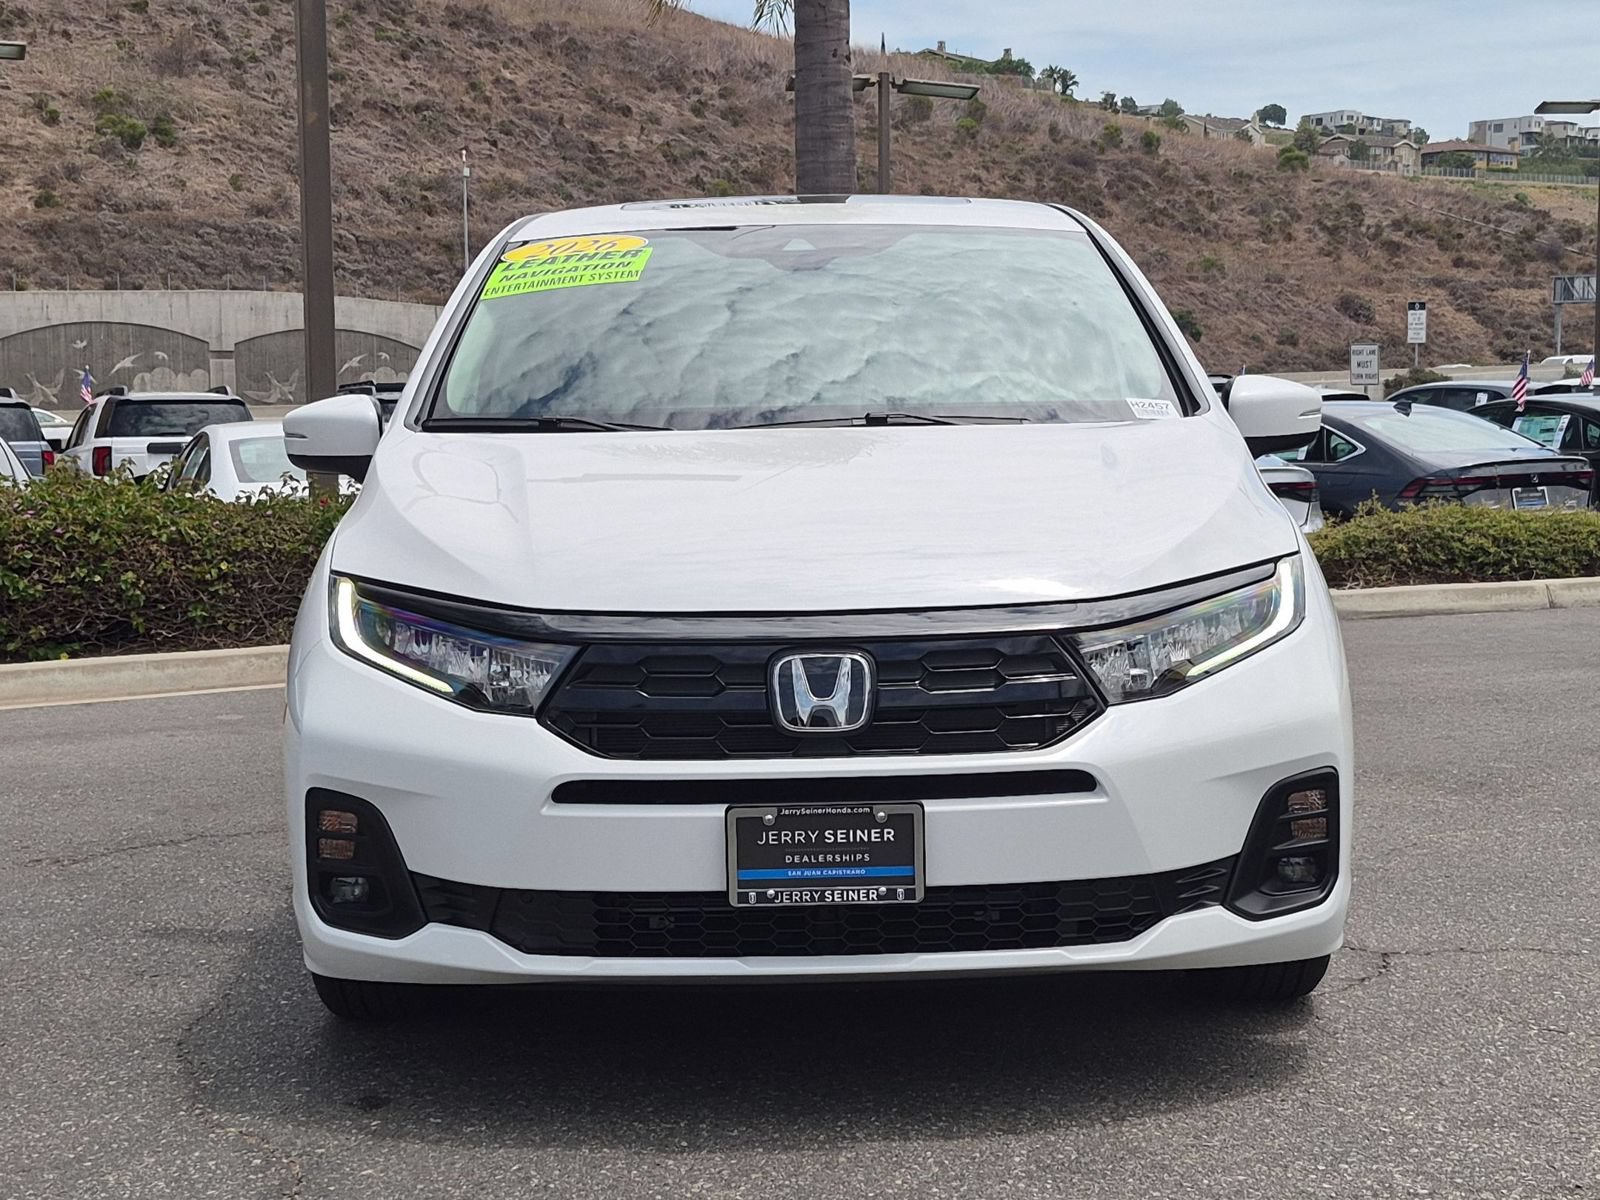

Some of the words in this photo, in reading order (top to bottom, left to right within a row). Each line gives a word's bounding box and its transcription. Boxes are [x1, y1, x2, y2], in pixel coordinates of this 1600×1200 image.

[501, 249, 643, 272] LEATHER
[498, 261, 633, 283] NAVIGATION
[484, 273, 584, 296] ENTERTAINMENT
[588, 270, 640, 282] SYSTEM
[1356, 360, 1372, 368] MUST
[780, 807, 871, 816] JerrySeinerHonda.com
[757, 830, 820, 845] JERRY
[824, 828, 895, 843] SEINER
[785, 853, 871, 863] DEALERSHIPS
[774, 891, 822, 903] JERRY
[824, 889, 877, 902] SEINER
